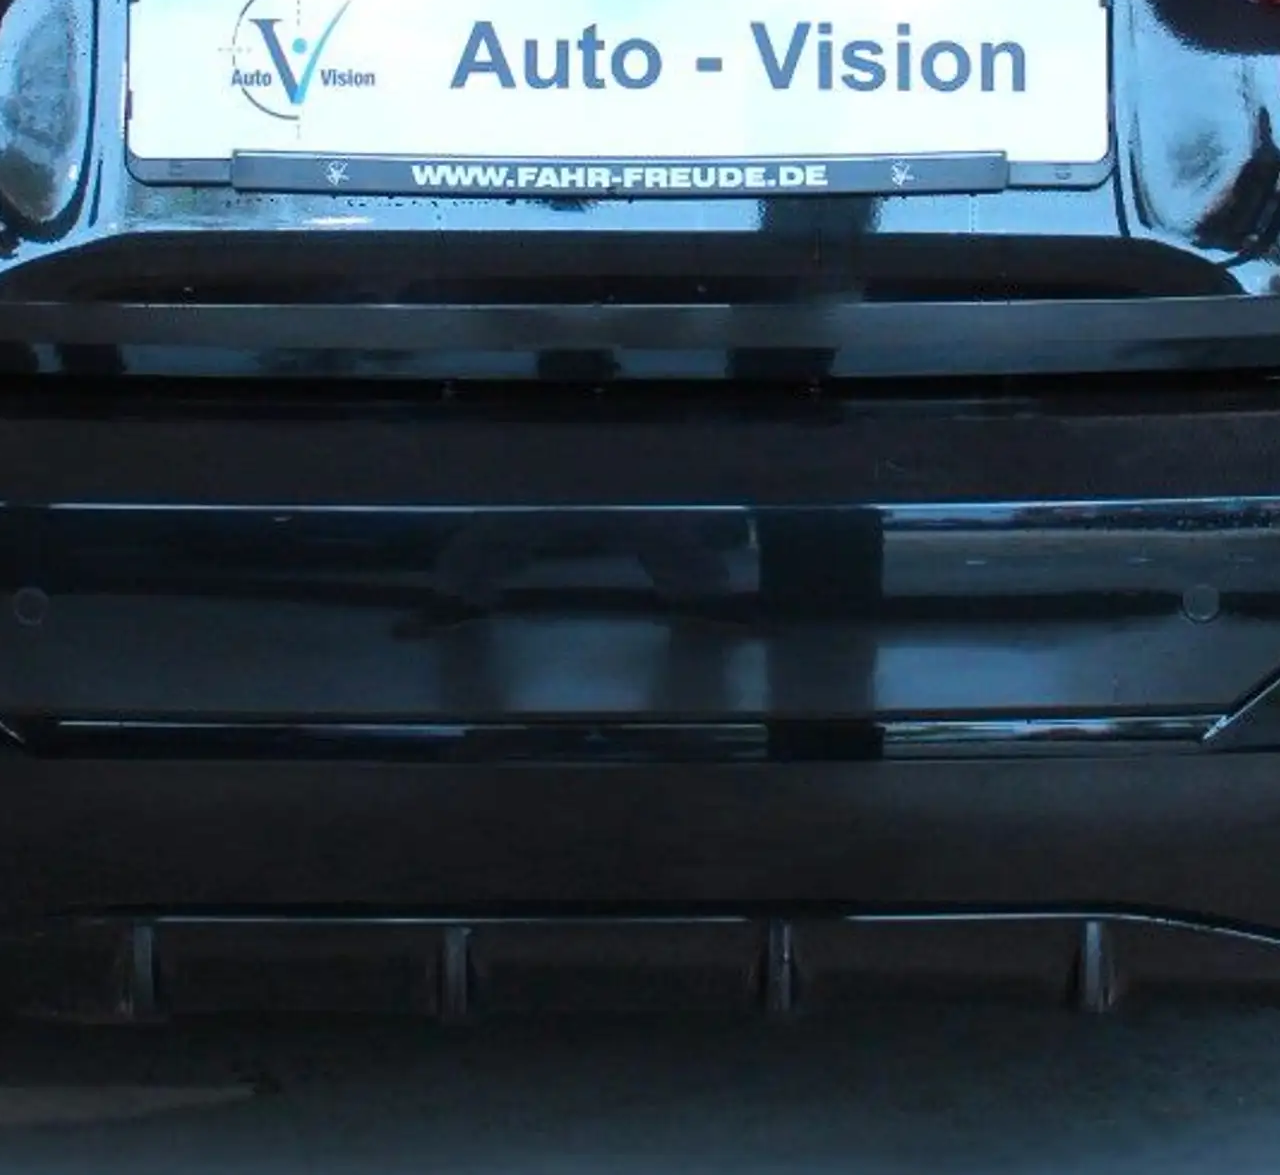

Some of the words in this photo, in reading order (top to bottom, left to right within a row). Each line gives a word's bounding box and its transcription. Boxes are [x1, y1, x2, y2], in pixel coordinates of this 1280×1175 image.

[450, 21, 662, 90] Auto
[750, 21, 1026, 92] Vision
[231, 68, 272, 87] Auto
[320, 68, 376, 87] Vision
[410, 164, 829, 189] WWW.FAHR-FREUDE.DE
